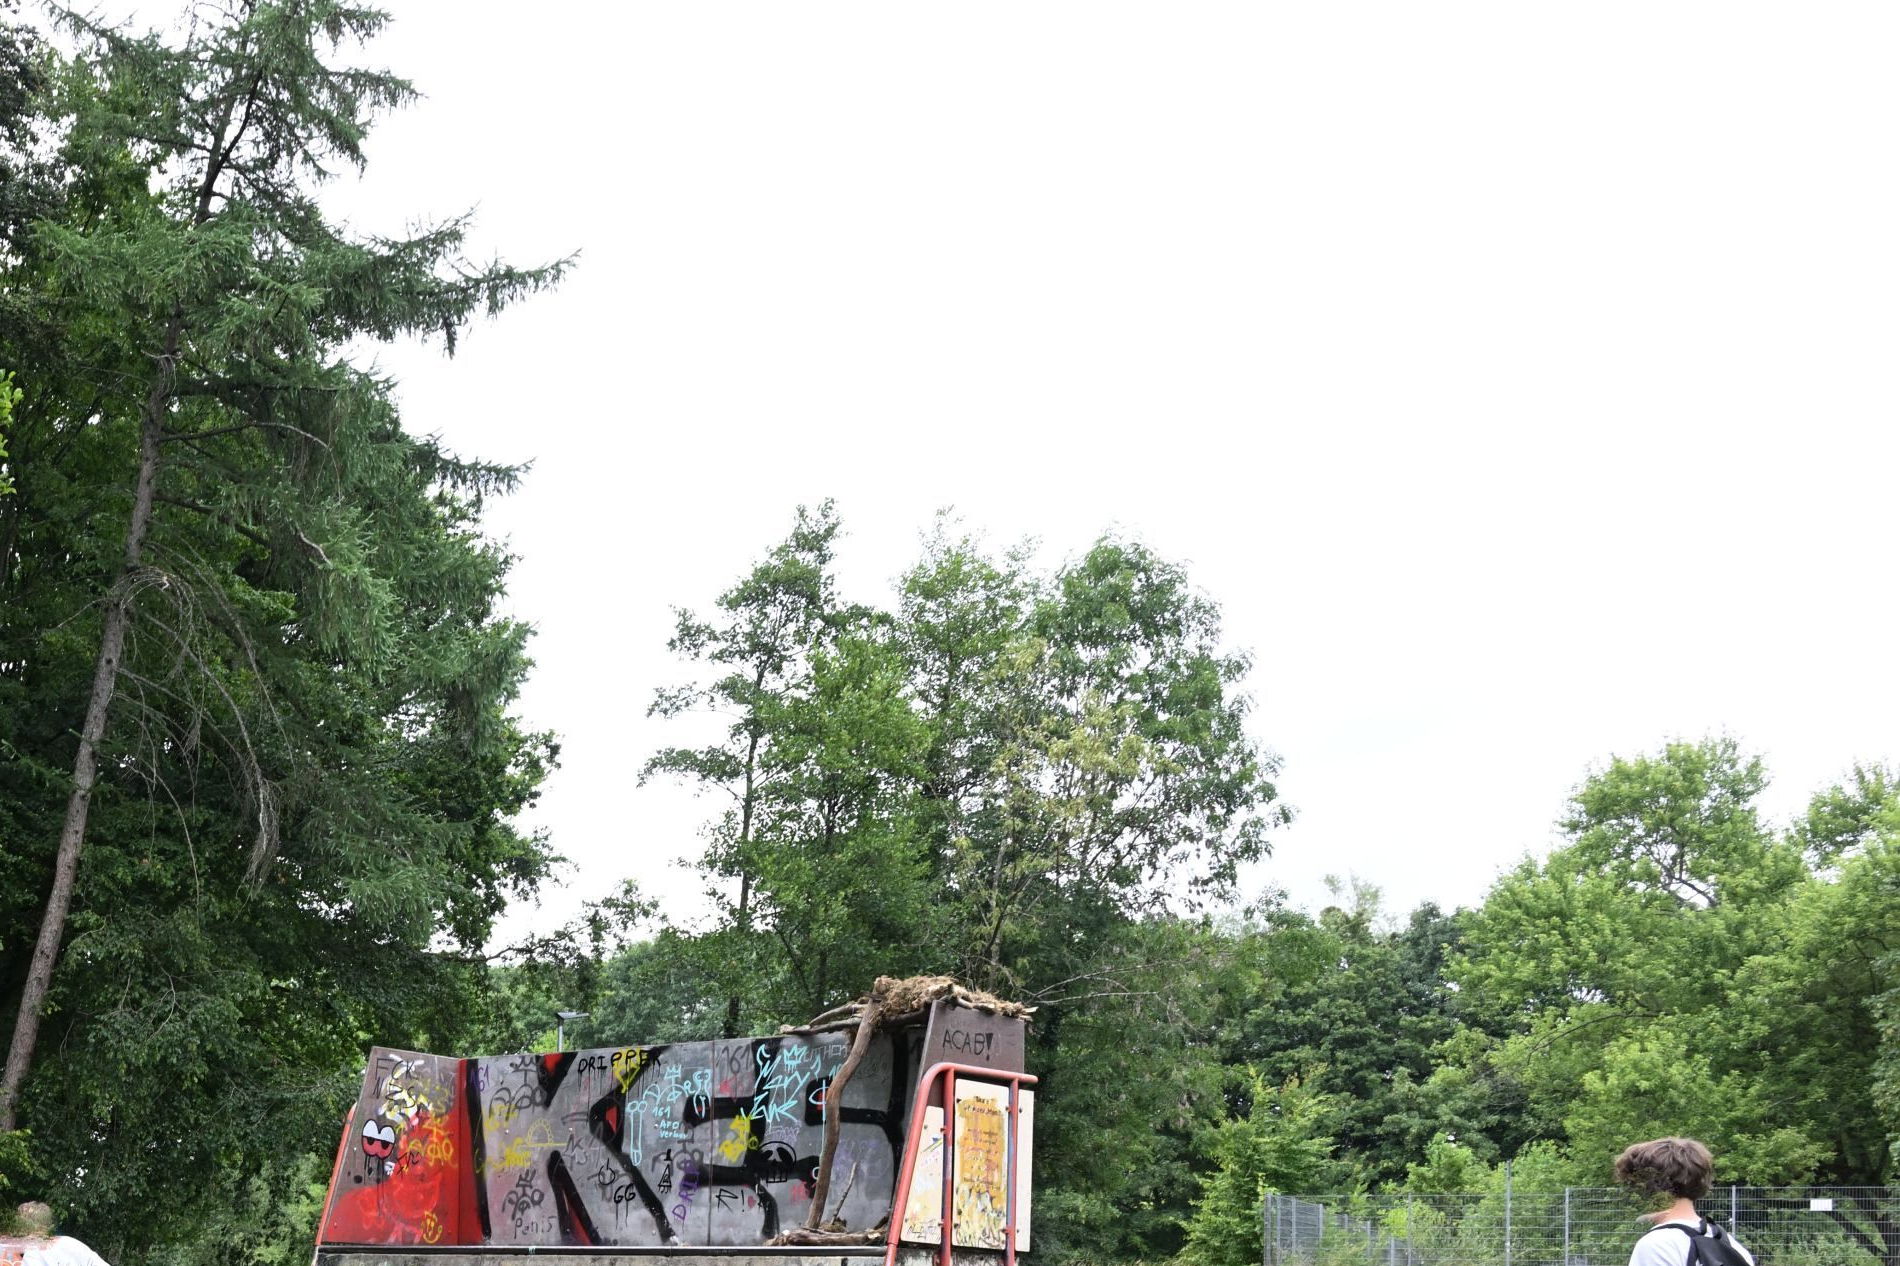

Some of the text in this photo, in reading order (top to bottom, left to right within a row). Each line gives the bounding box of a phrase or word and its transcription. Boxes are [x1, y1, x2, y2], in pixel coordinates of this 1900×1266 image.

[942, 1029, 993, 1062] ACAB!
[375, 1057, 419, 1081] FCK
[578, 1049, 662, 1074] DRIPPER
